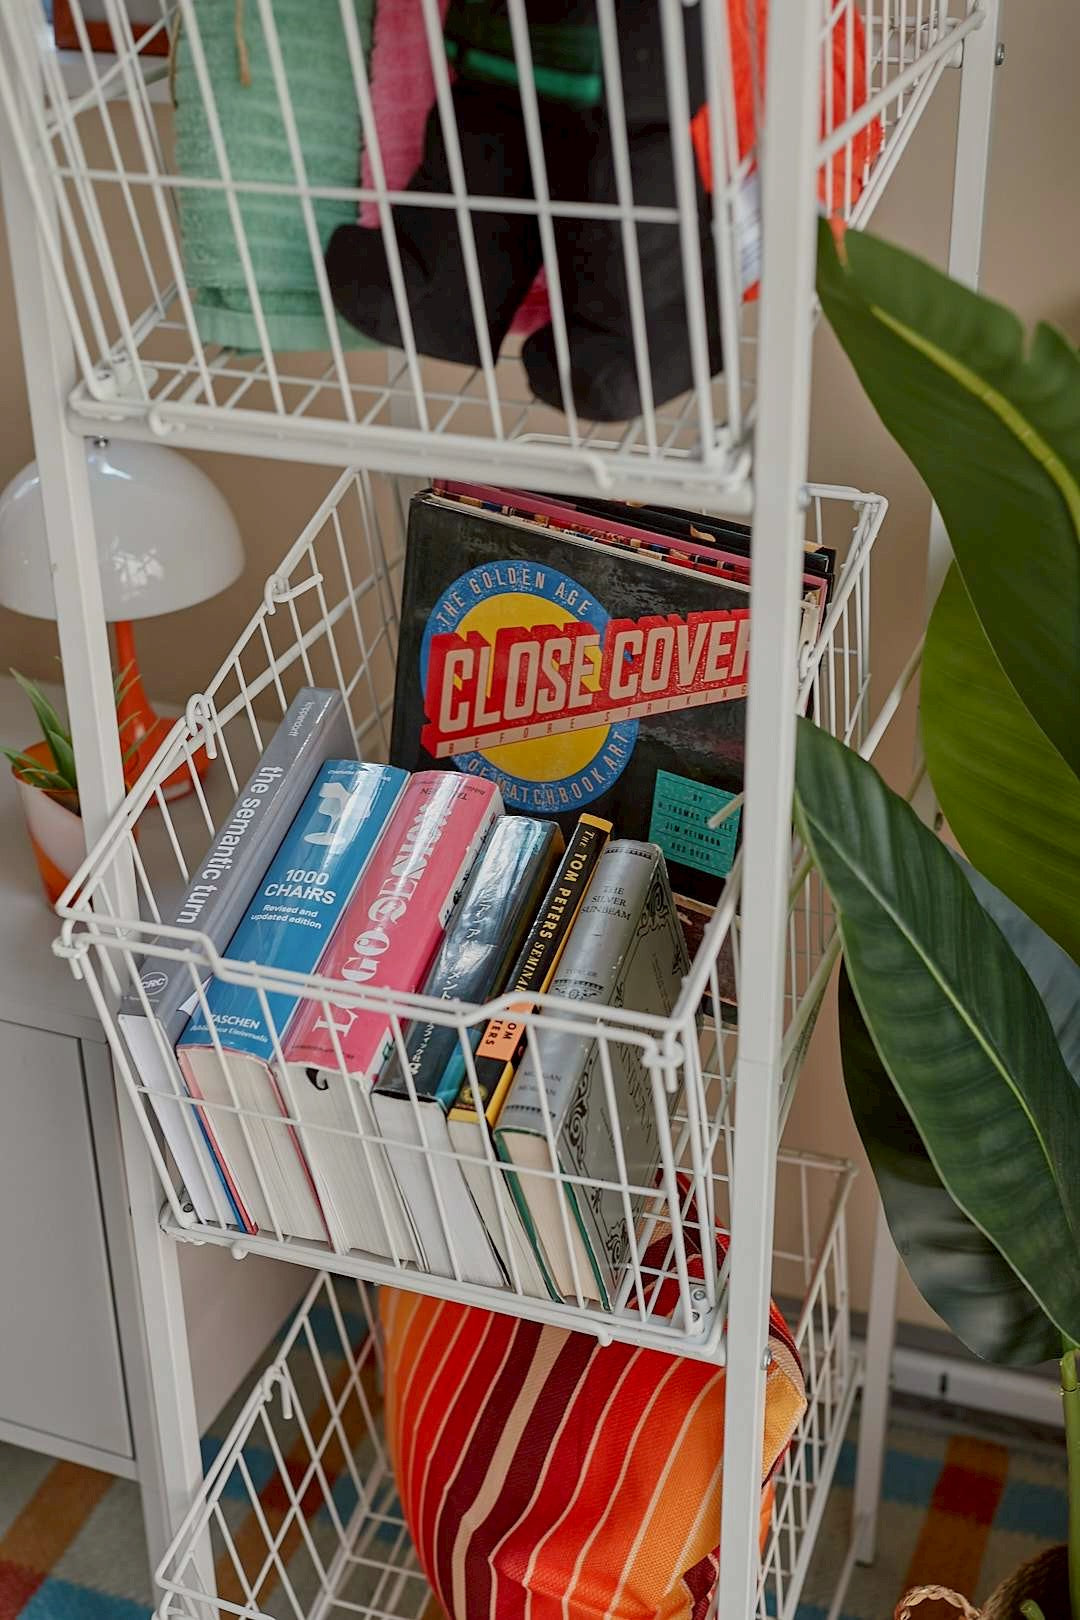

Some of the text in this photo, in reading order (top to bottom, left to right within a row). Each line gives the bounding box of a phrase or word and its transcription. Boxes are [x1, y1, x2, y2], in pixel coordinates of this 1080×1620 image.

[436, 567, 593, 627] THE GOLDEN AGE
[438, 634, 601, 734] CLOSE
[603, 731, 632, 770] ART
[176, 766, 284, 924] the semantic turn
[286, 869, 329, 885] 1000
[564, 854, 588, 882] TOM
[264, 883, 336, 905] CHAIRS
[251, 913, 322, 929] updated edition
[262, 904, 319, 918] Revised and
[539, 887, 572, 940] PETERS
[312, 929, 390, 1038] LGO
[503, 1021, 517, 1040] OM
